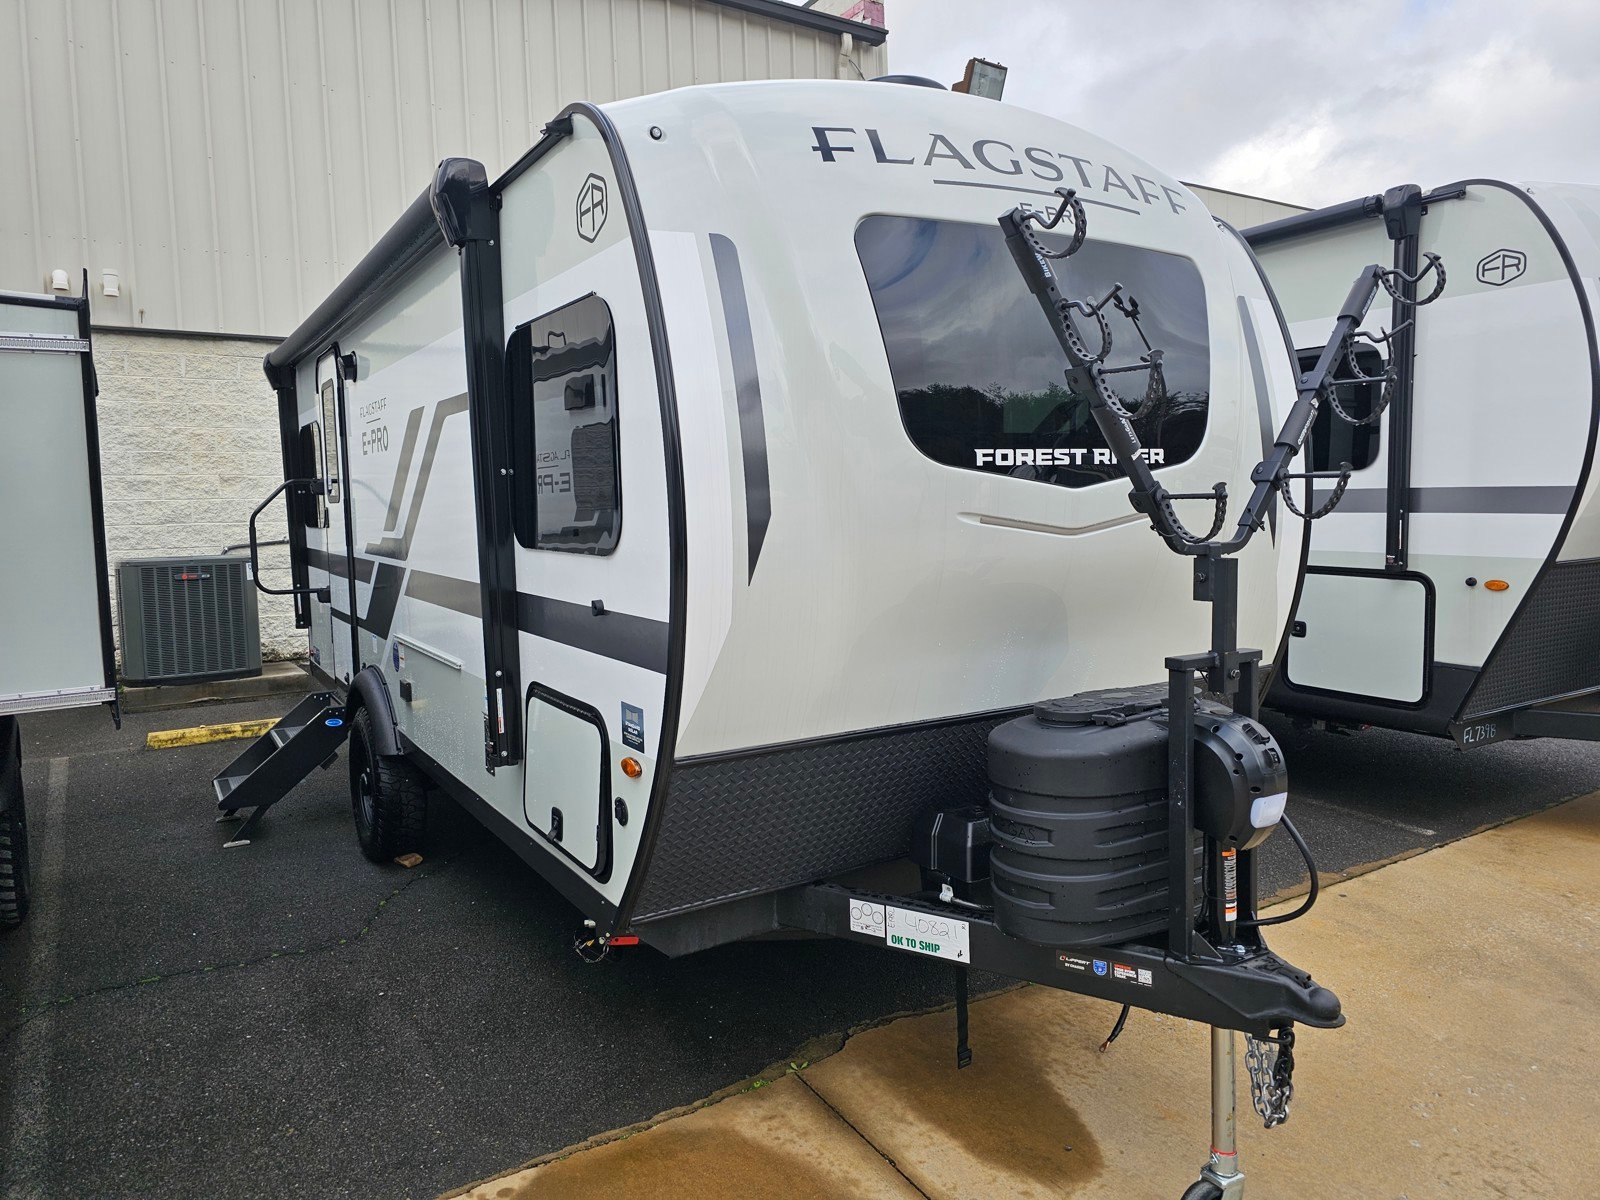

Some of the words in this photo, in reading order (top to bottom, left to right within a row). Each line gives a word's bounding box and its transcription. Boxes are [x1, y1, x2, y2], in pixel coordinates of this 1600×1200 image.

[811, 126, 1188, 215] FLAGSTAFF
[1020, 202, 1075, 224] E-PR
[360, 397, 387, 418] FLAGSTAFF
[362, 425, 389, 455] E-PRO
[974, 448, 1087, 467] FOREST
[1092, 448, 1165, 464] RIER
[891, 934, 903, 946] OK
[905, 937, 917, 949] TO
[919, 940, 941, 953] SHIP
